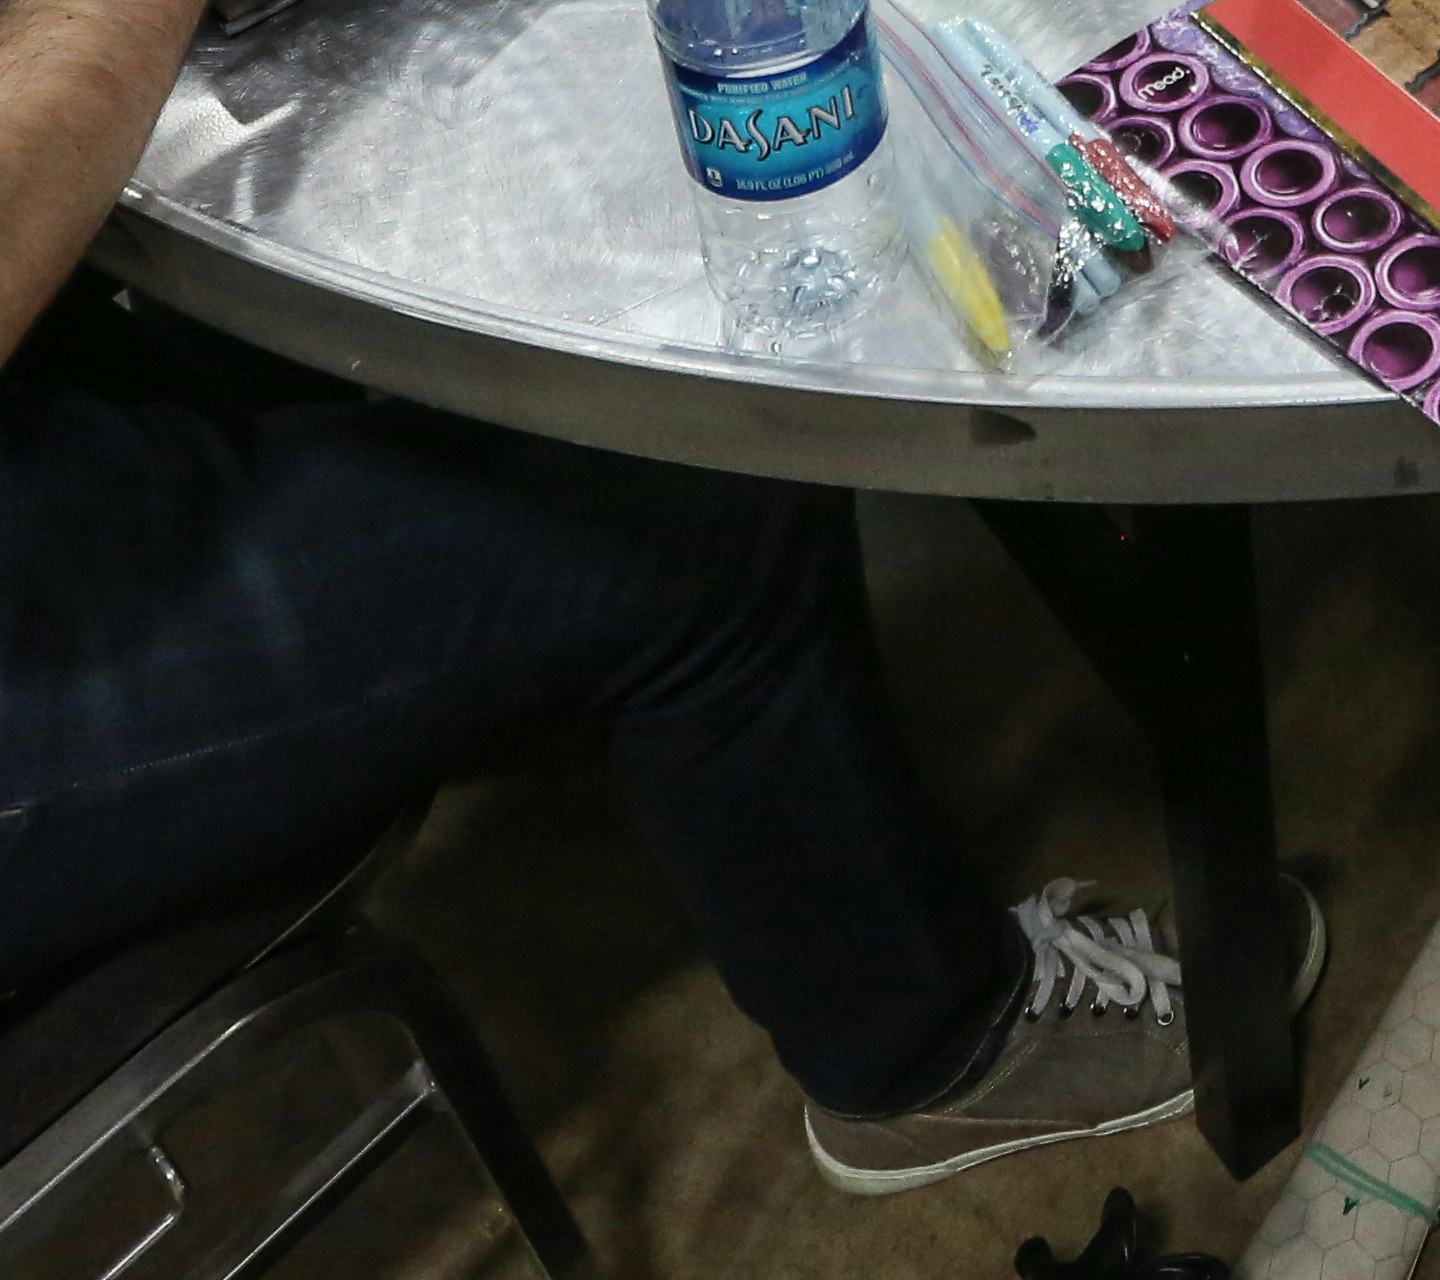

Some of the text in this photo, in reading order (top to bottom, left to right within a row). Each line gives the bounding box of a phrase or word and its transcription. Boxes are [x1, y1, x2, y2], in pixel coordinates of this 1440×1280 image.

[717, 72, 809, 95] PURIFIED WATER
[1137, 66, 1187, 102] mead
[687, 85, 855, 162] DASANI
